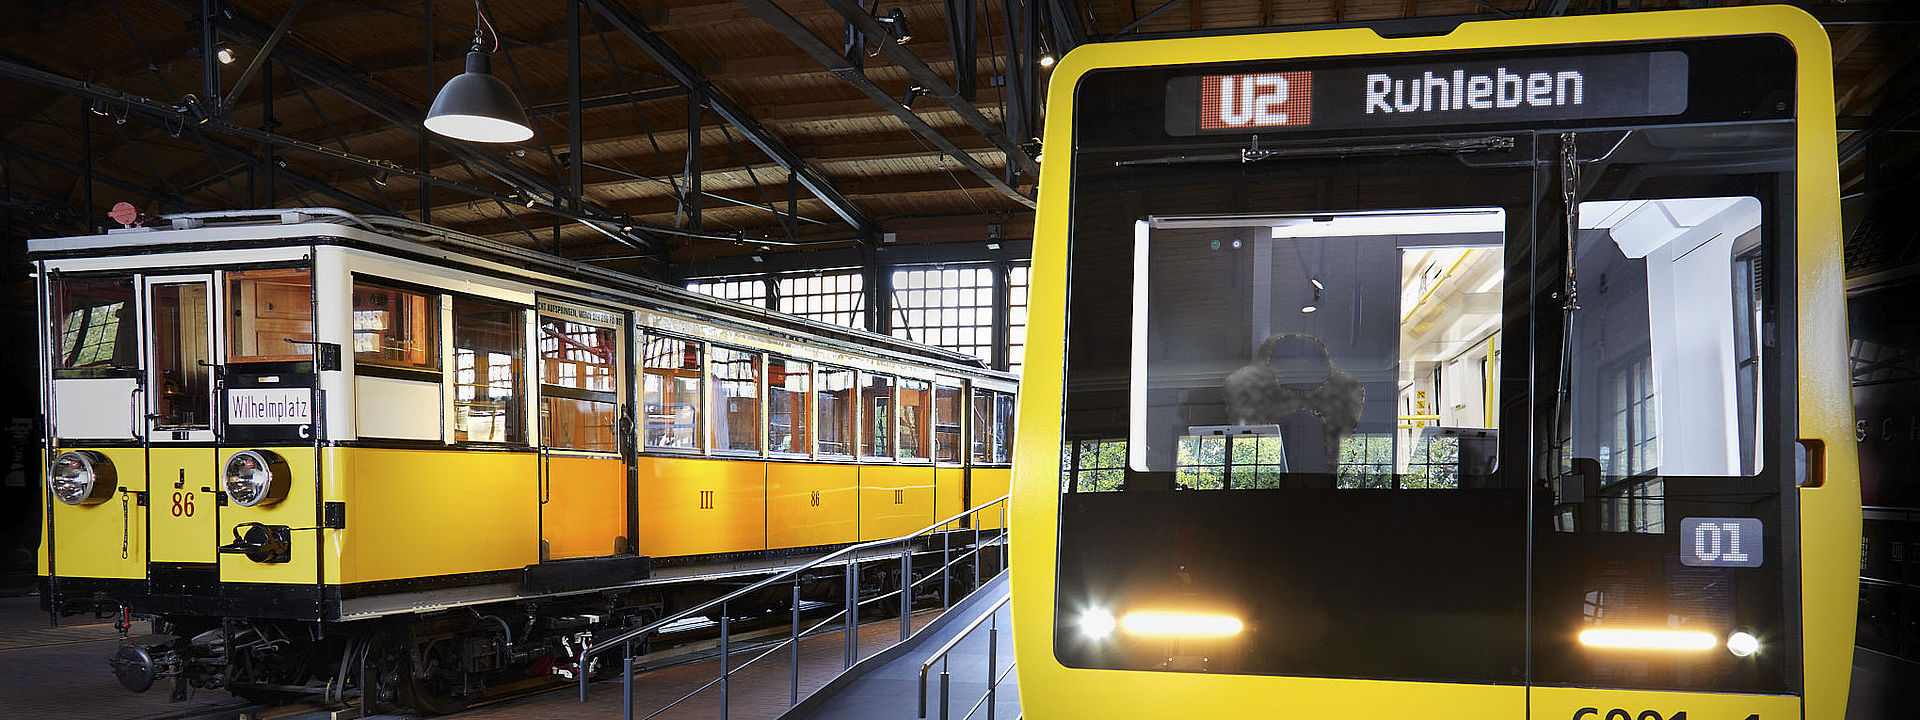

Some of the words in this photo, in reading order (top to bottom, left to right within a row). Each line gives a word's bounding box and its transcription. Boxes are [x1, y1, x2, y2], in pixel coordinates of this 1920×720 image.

[1221, 75, 1287, 126] U2
[1366, 68, 1584, 114] Ruhleben
[232, 395, 308, 422] Wilhelmplatz
[298, 424, 310, 438] C
[171, 492, 195, 517] 86
[810, 490, 821, 507] 86
[1696, 522, 1748, 561] 01
